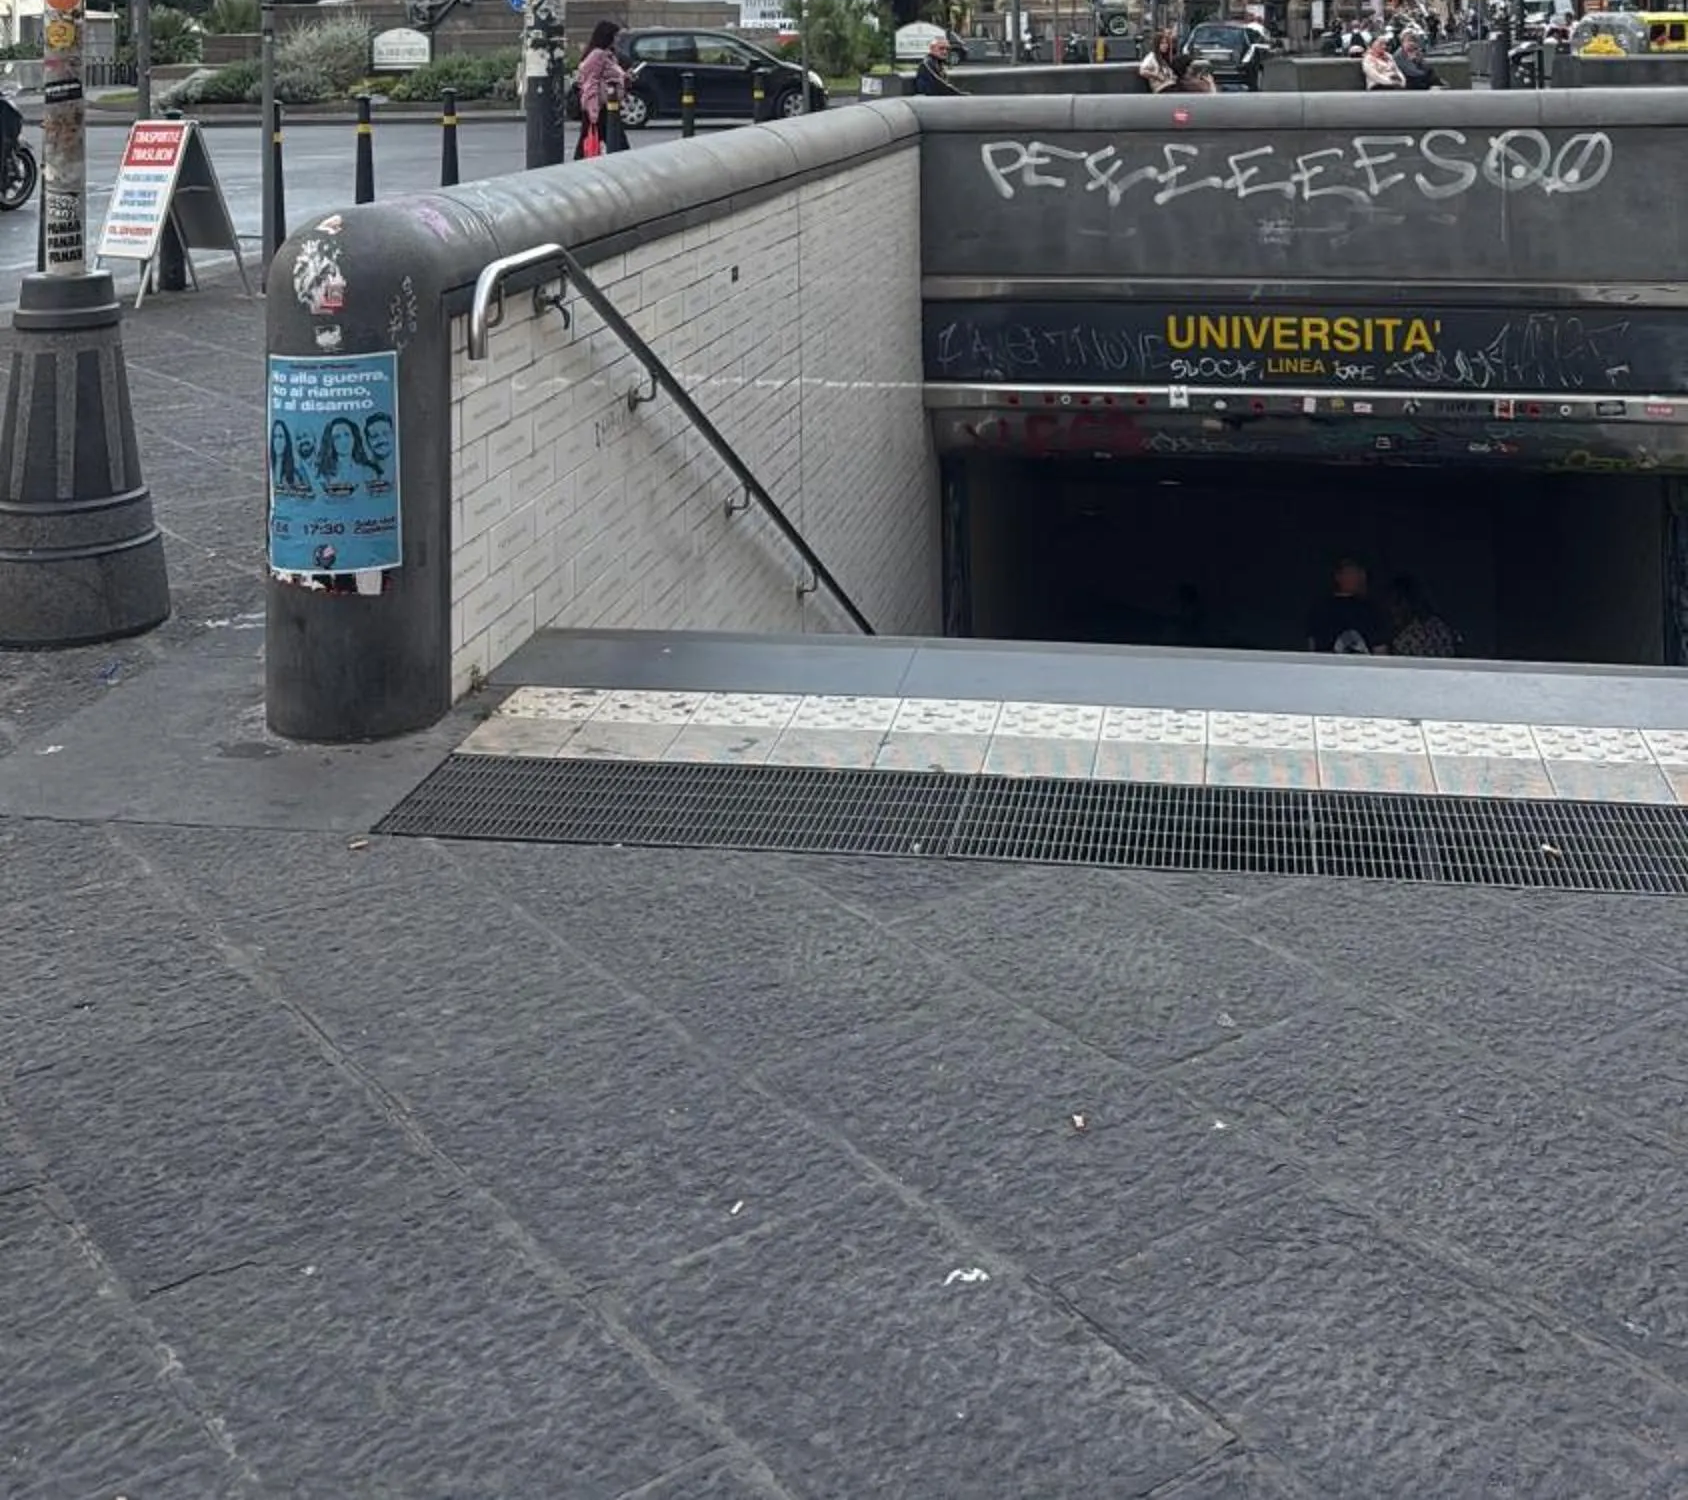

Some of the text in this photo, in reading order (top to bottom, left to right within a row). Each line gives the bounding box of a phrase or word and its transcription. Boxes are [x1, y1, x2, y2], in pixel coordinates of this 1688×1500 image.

[1167, 315, 1441, 354] UNIVERSITA'
[1267, 357, 1325, 373] LINEA
[290, 371, 317, 385] alla
[285, 398, 297, 411] al
[303, 523, 345, 536] 17:30
